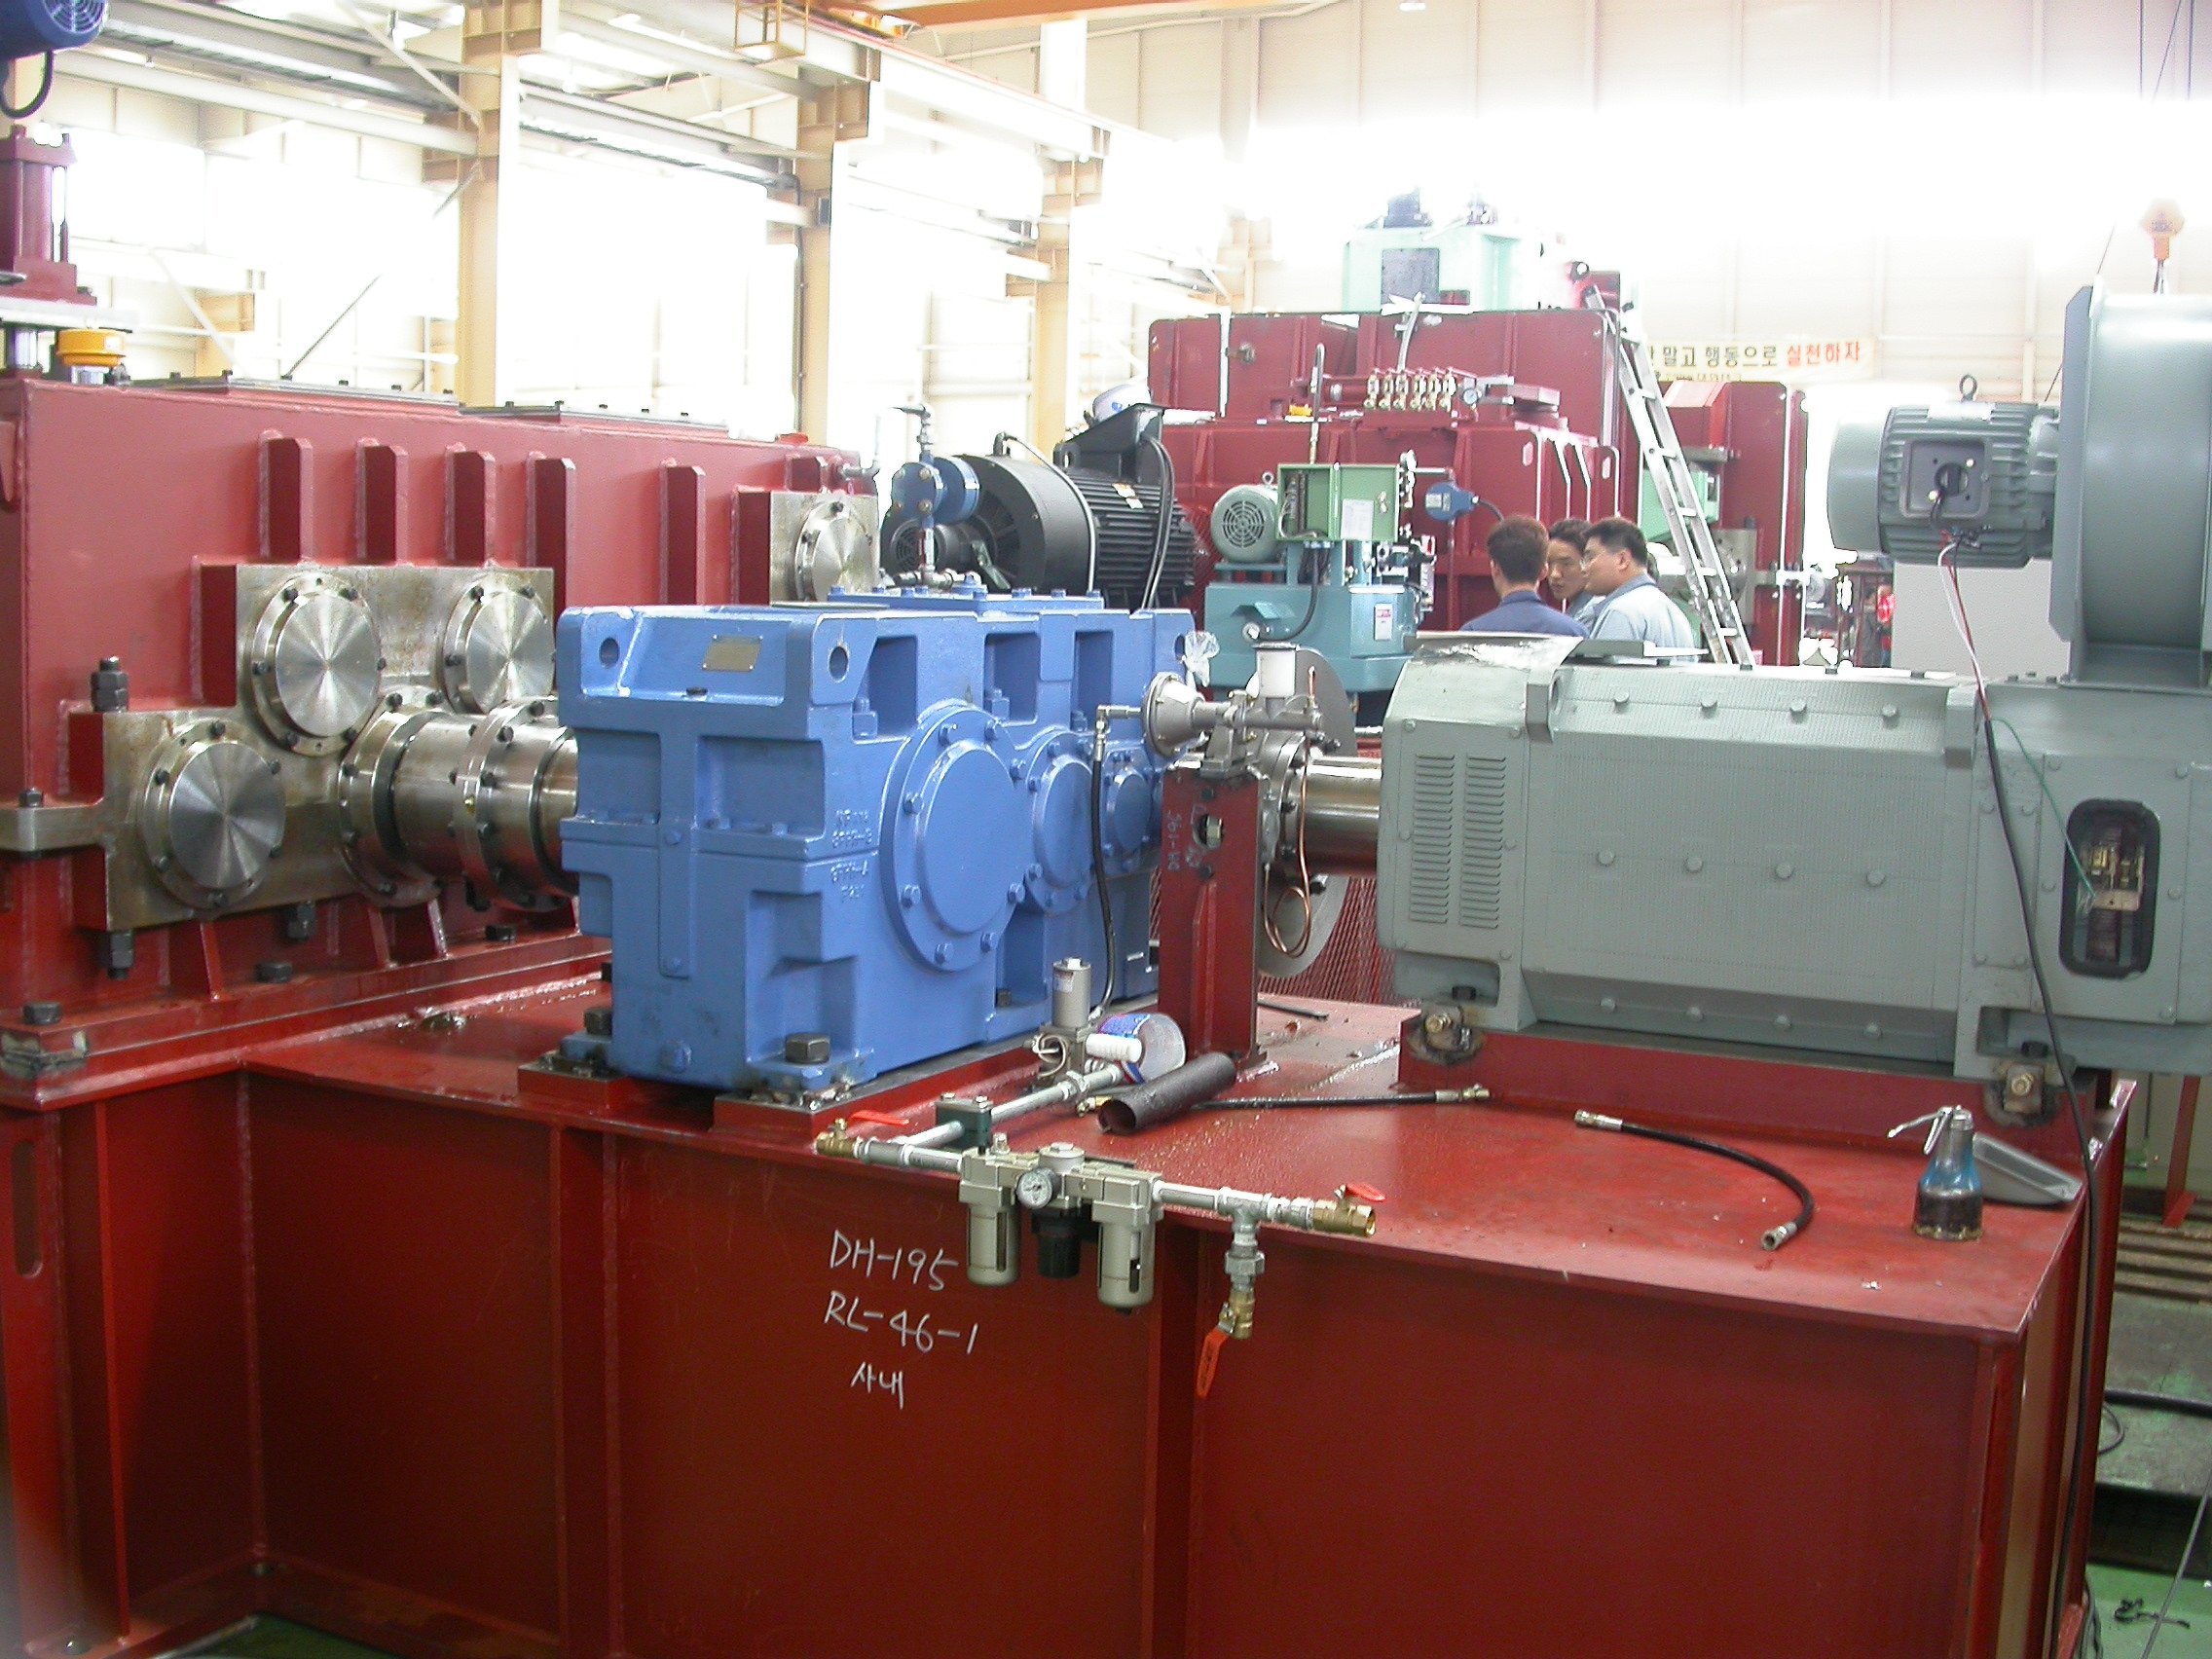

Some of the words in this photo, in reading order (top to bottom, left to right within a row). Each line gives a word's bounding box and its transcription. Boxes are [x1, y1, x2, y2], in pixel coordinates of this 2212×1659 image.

[1663, 345, 1697, 367] 말고
[1705, 345, 1778, 367] 행동으로
[1787, 341, 1861, 367] 실천하자
[830, 1229, 959, 1291] DH-195
[825, 1290, 978, 1354] RL-46-1
[850, 1361, 904, 1410] 사내
